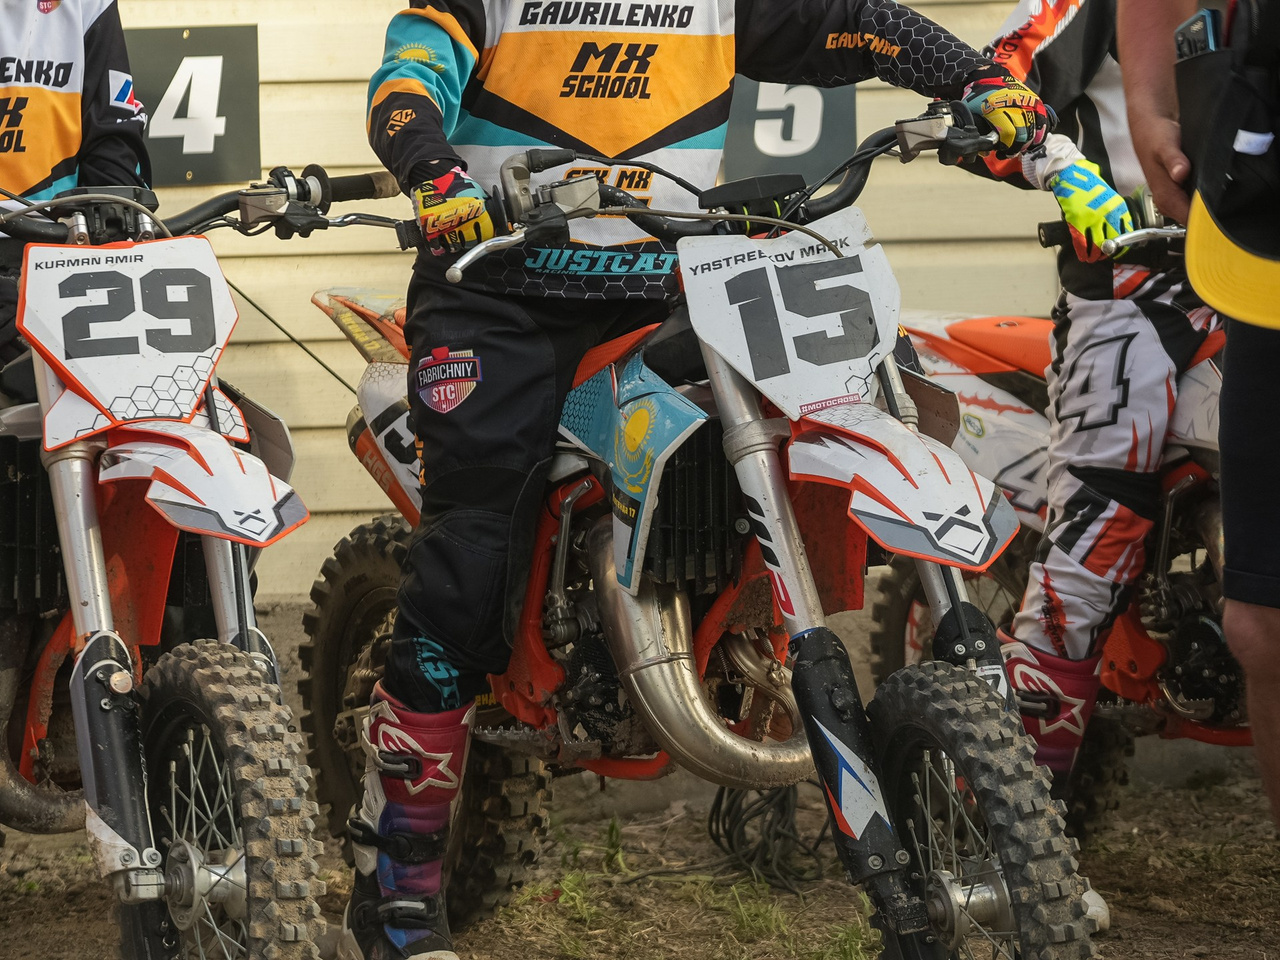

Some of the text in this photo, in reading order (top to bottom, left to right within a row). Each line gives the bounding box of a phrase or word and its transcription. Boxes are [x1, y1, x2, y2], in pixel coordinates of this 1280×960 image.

[39, 1, 53, 10] STC
[518, 1, 695, 29] GAVRILENKO
[569, 42, 658, 74] MX
[560, 75, 651, 100] SCHOOL
[148, 55, 226, 154] 4
[754, 82, 824, 157] 5
[615, 170, 652, 189] MX
[34, 254, 144, 271] KURMAN AMIR
[58, 268, 217, 360] 29
[724, 255, 881, 381] 15
[418, 362, 473, 387] FABRICHNIY
[1058, 332, 1139, 432] 4
[432, 384, 456, 402] STC
[801, 395, 859, 413] #MOTOCROSS
[363, 448, 394, 493] HGS
